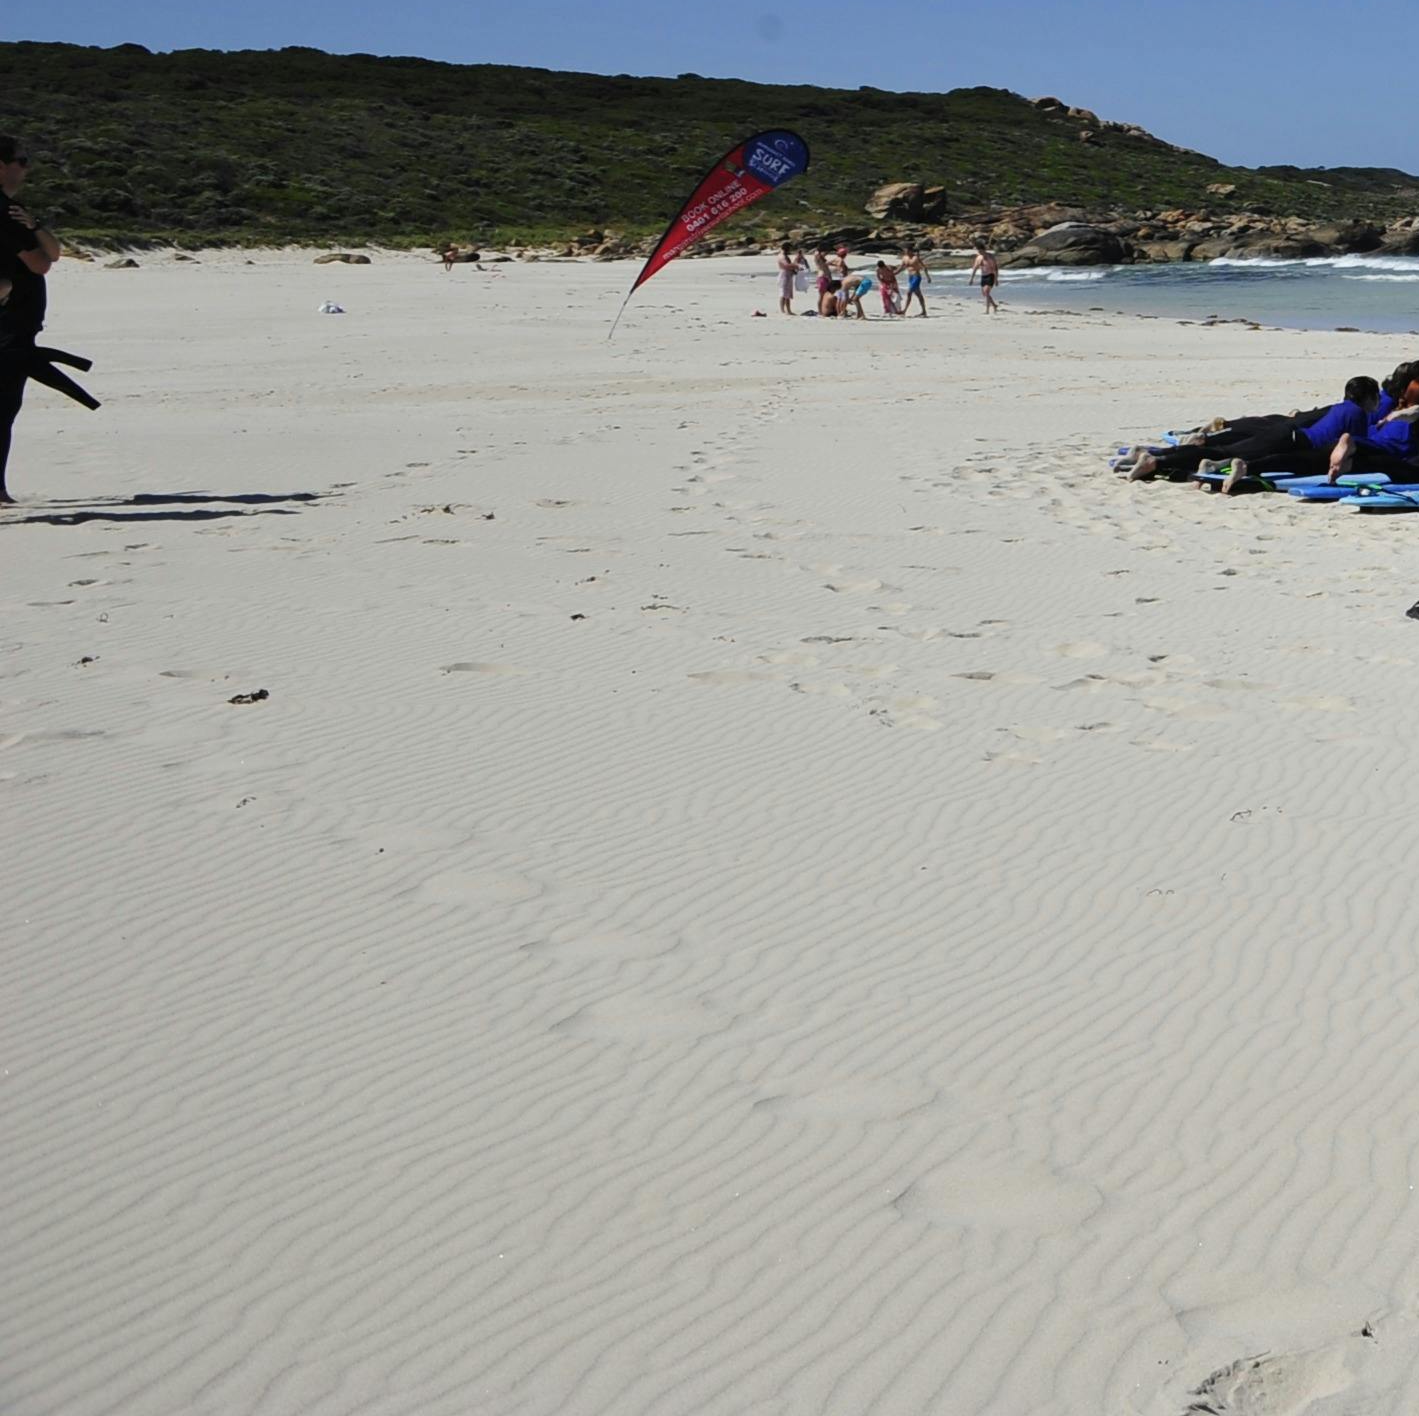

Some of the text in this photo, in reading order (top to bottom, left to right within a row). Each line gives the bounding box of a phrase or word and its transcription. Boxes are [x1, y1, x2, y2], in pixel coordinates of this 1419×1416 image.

[752, 148, 791, 175] SURF
[681, 201, 709, 223] BOOK
[710, 199, 729, 215] 616
[729, 187, 748, 203] 200
